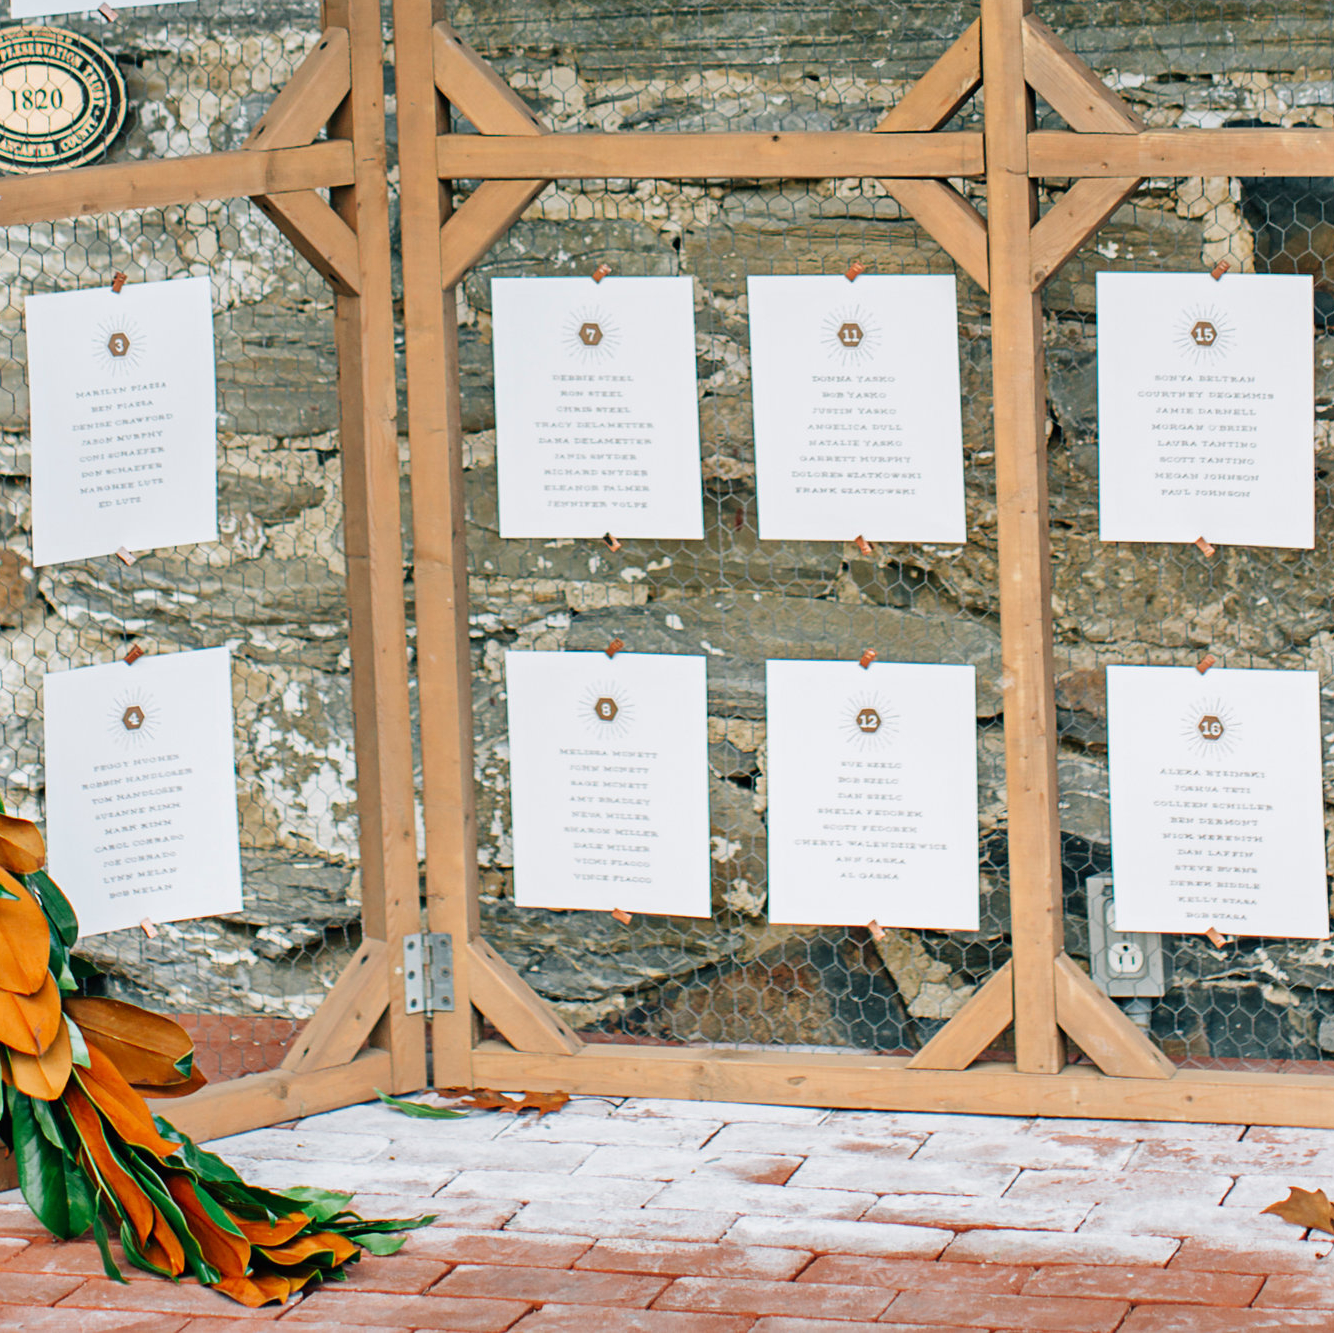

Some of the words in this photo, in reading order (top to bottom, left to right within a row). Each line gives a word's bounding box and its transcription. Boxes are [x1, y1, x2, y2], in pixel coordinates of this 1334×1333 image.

[0, 43, 83, 68] PRESERVATION
[83, 65, 105, 108] TRUST
[11, 88, 64, 112] 1820
[60, 118, 98, 151] COUNTY
